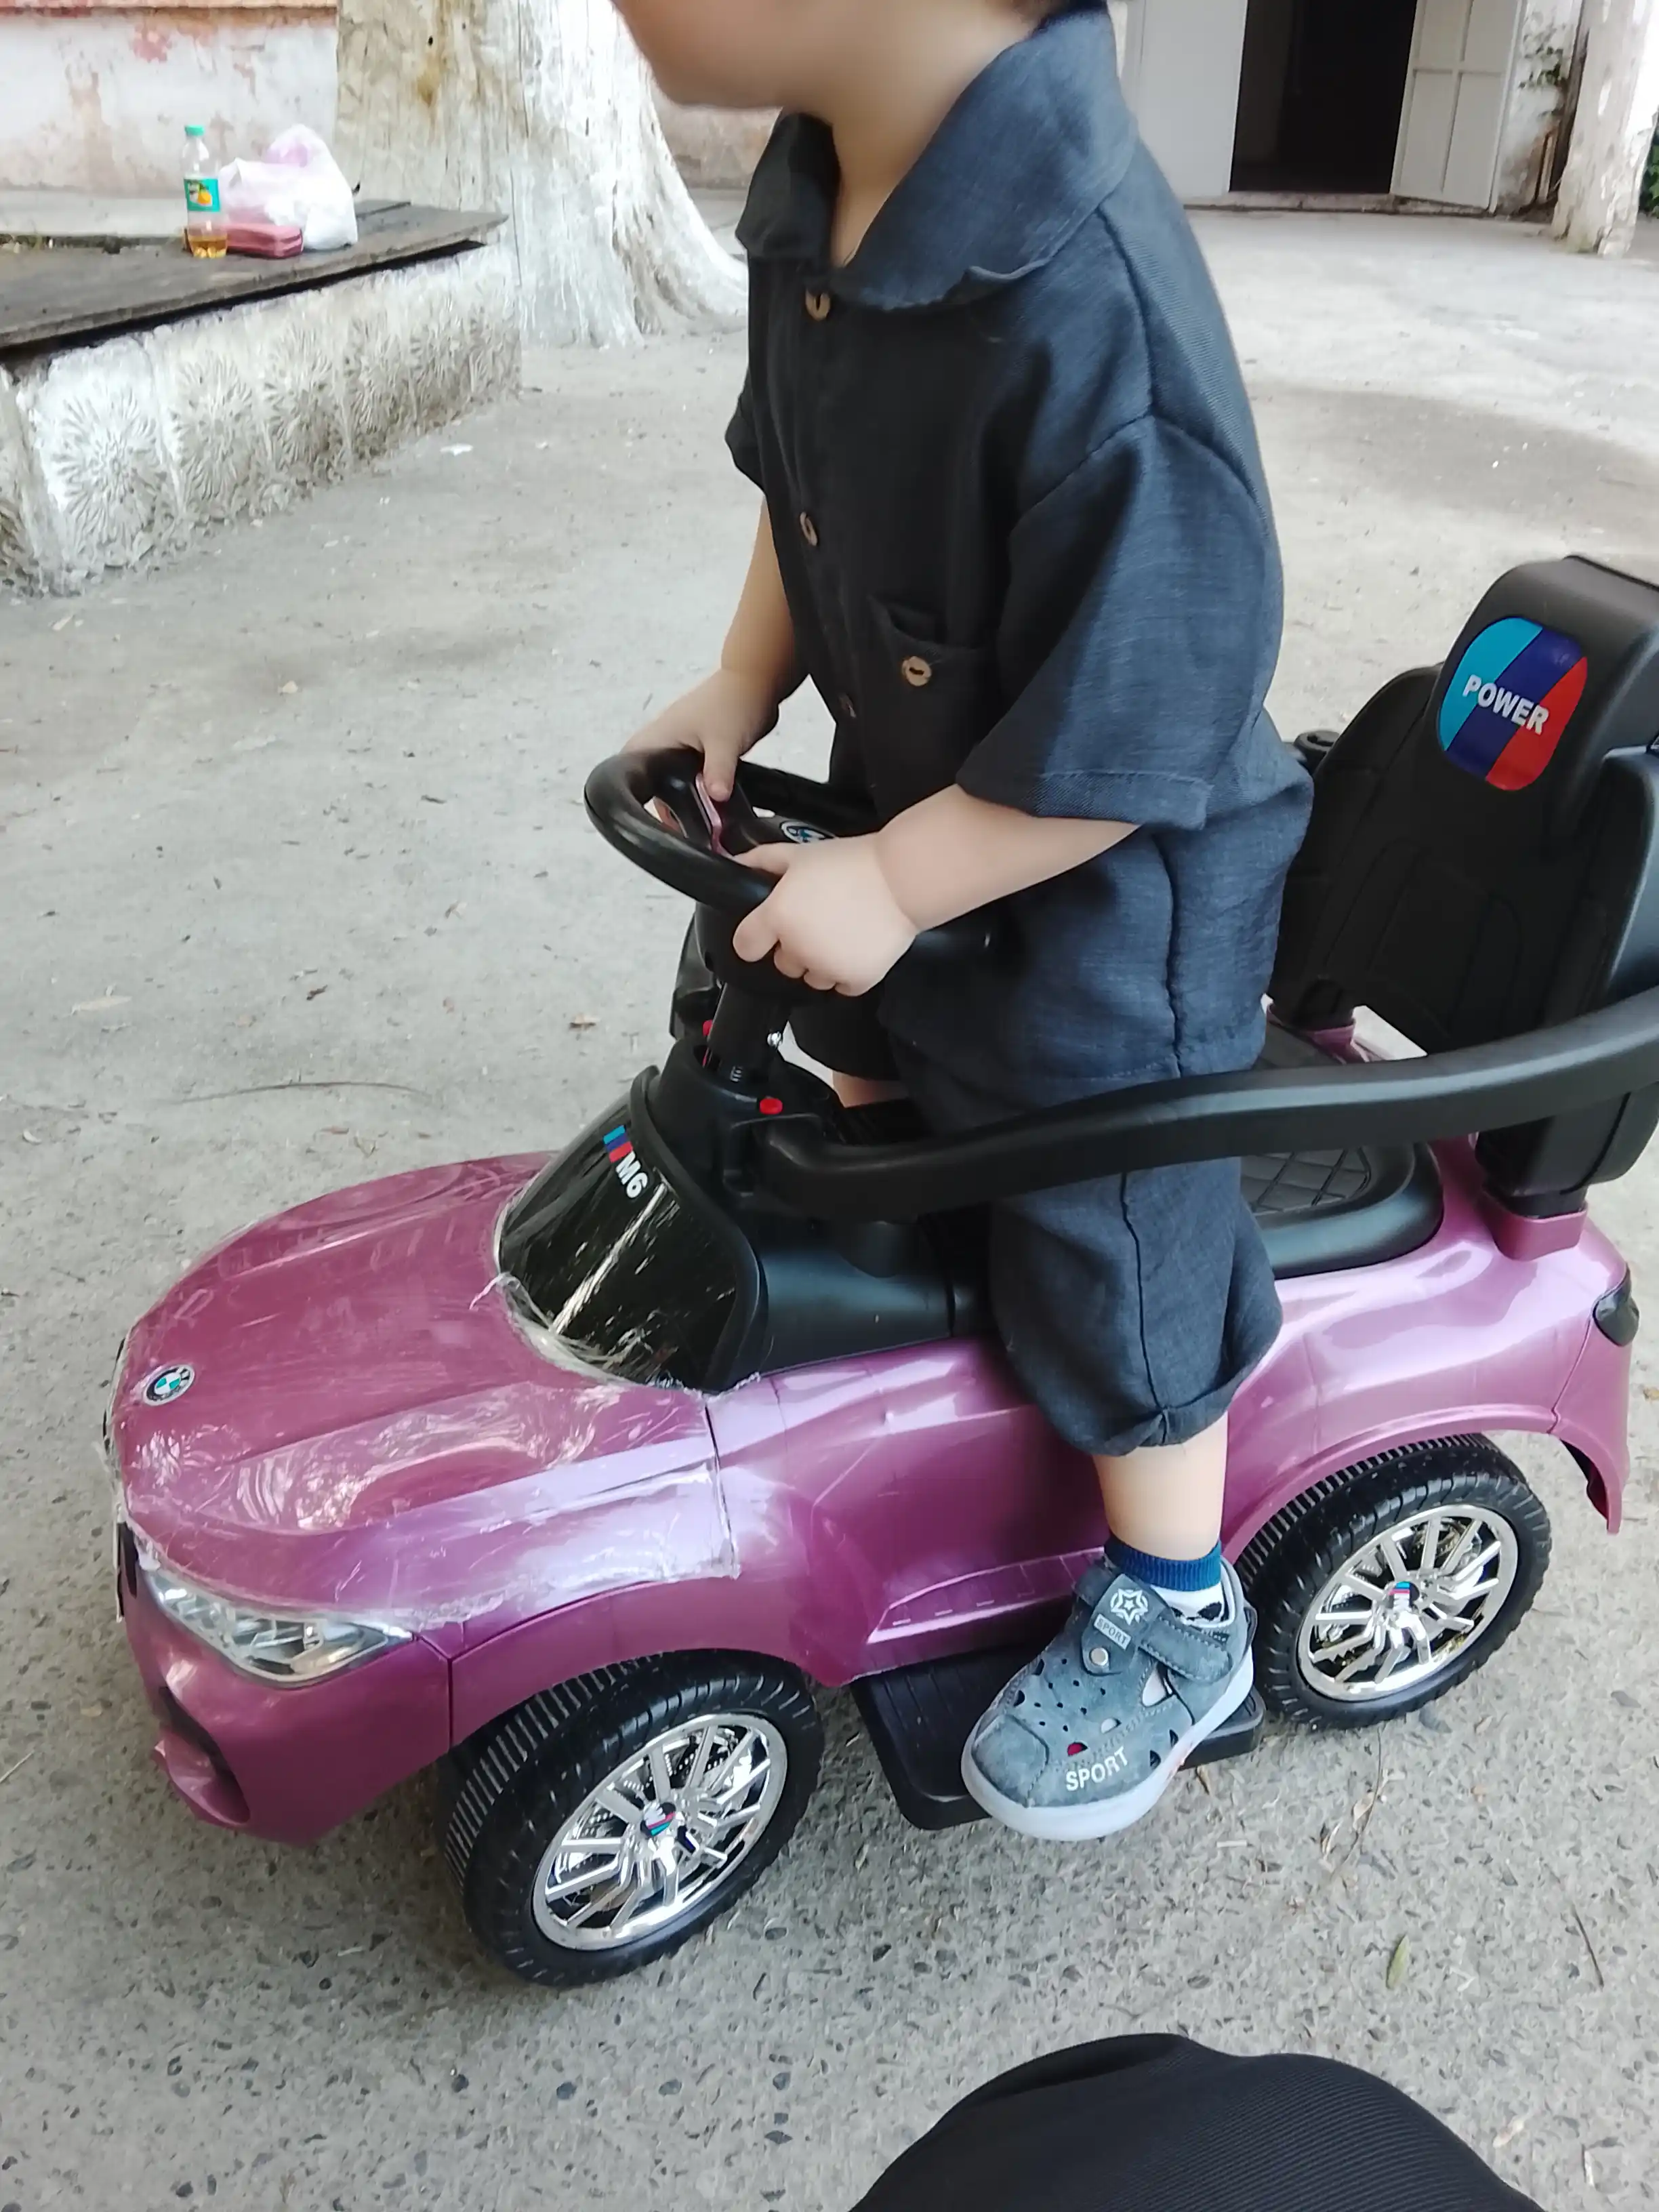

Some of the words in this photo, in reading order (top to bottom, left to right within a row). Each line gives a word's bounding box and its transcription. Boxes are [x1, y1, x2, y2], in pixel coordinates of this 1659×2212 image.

[1462, 674, 1549, 735] POWER
[615, 1151, 648, 1198] M6
[1096, 1616, 1130, 1645] SPORT
[1065, 1746, 1128, 1791] SPORT
